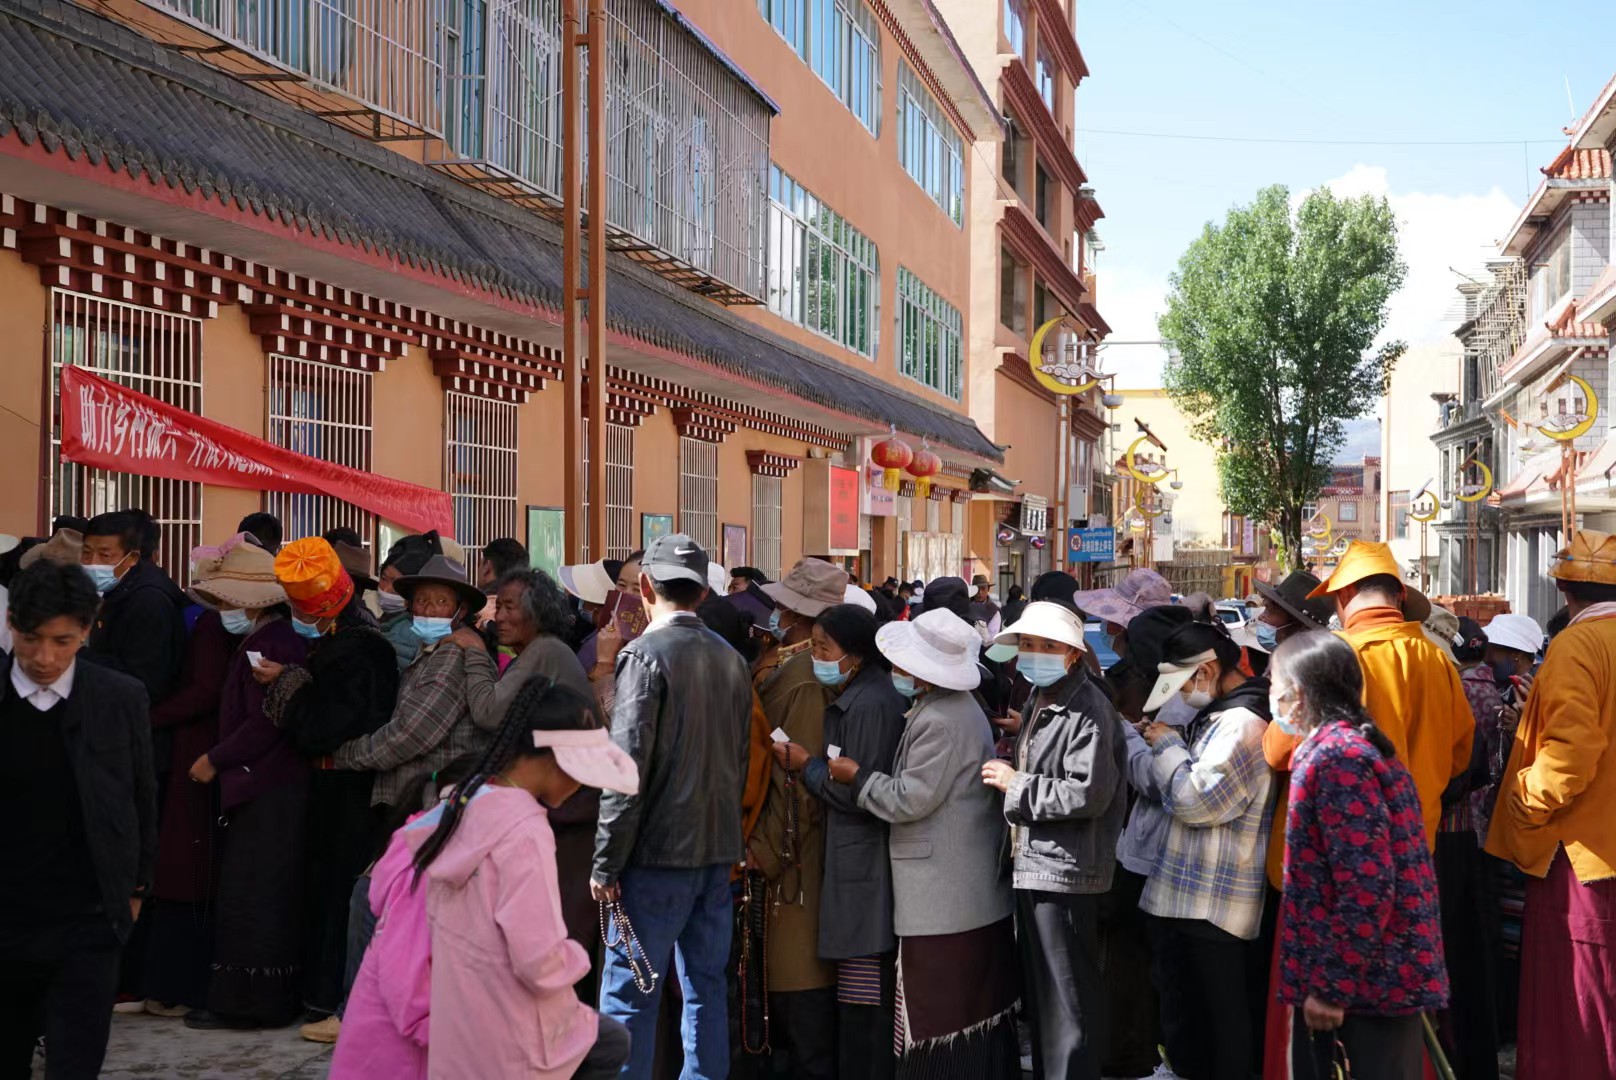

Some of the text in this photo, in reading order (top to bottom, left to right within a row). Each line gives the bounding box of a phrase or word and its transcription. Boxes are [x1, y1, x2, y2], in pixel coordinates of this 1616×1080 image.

[80, 383, 182, 461] 助力乡村振兴
